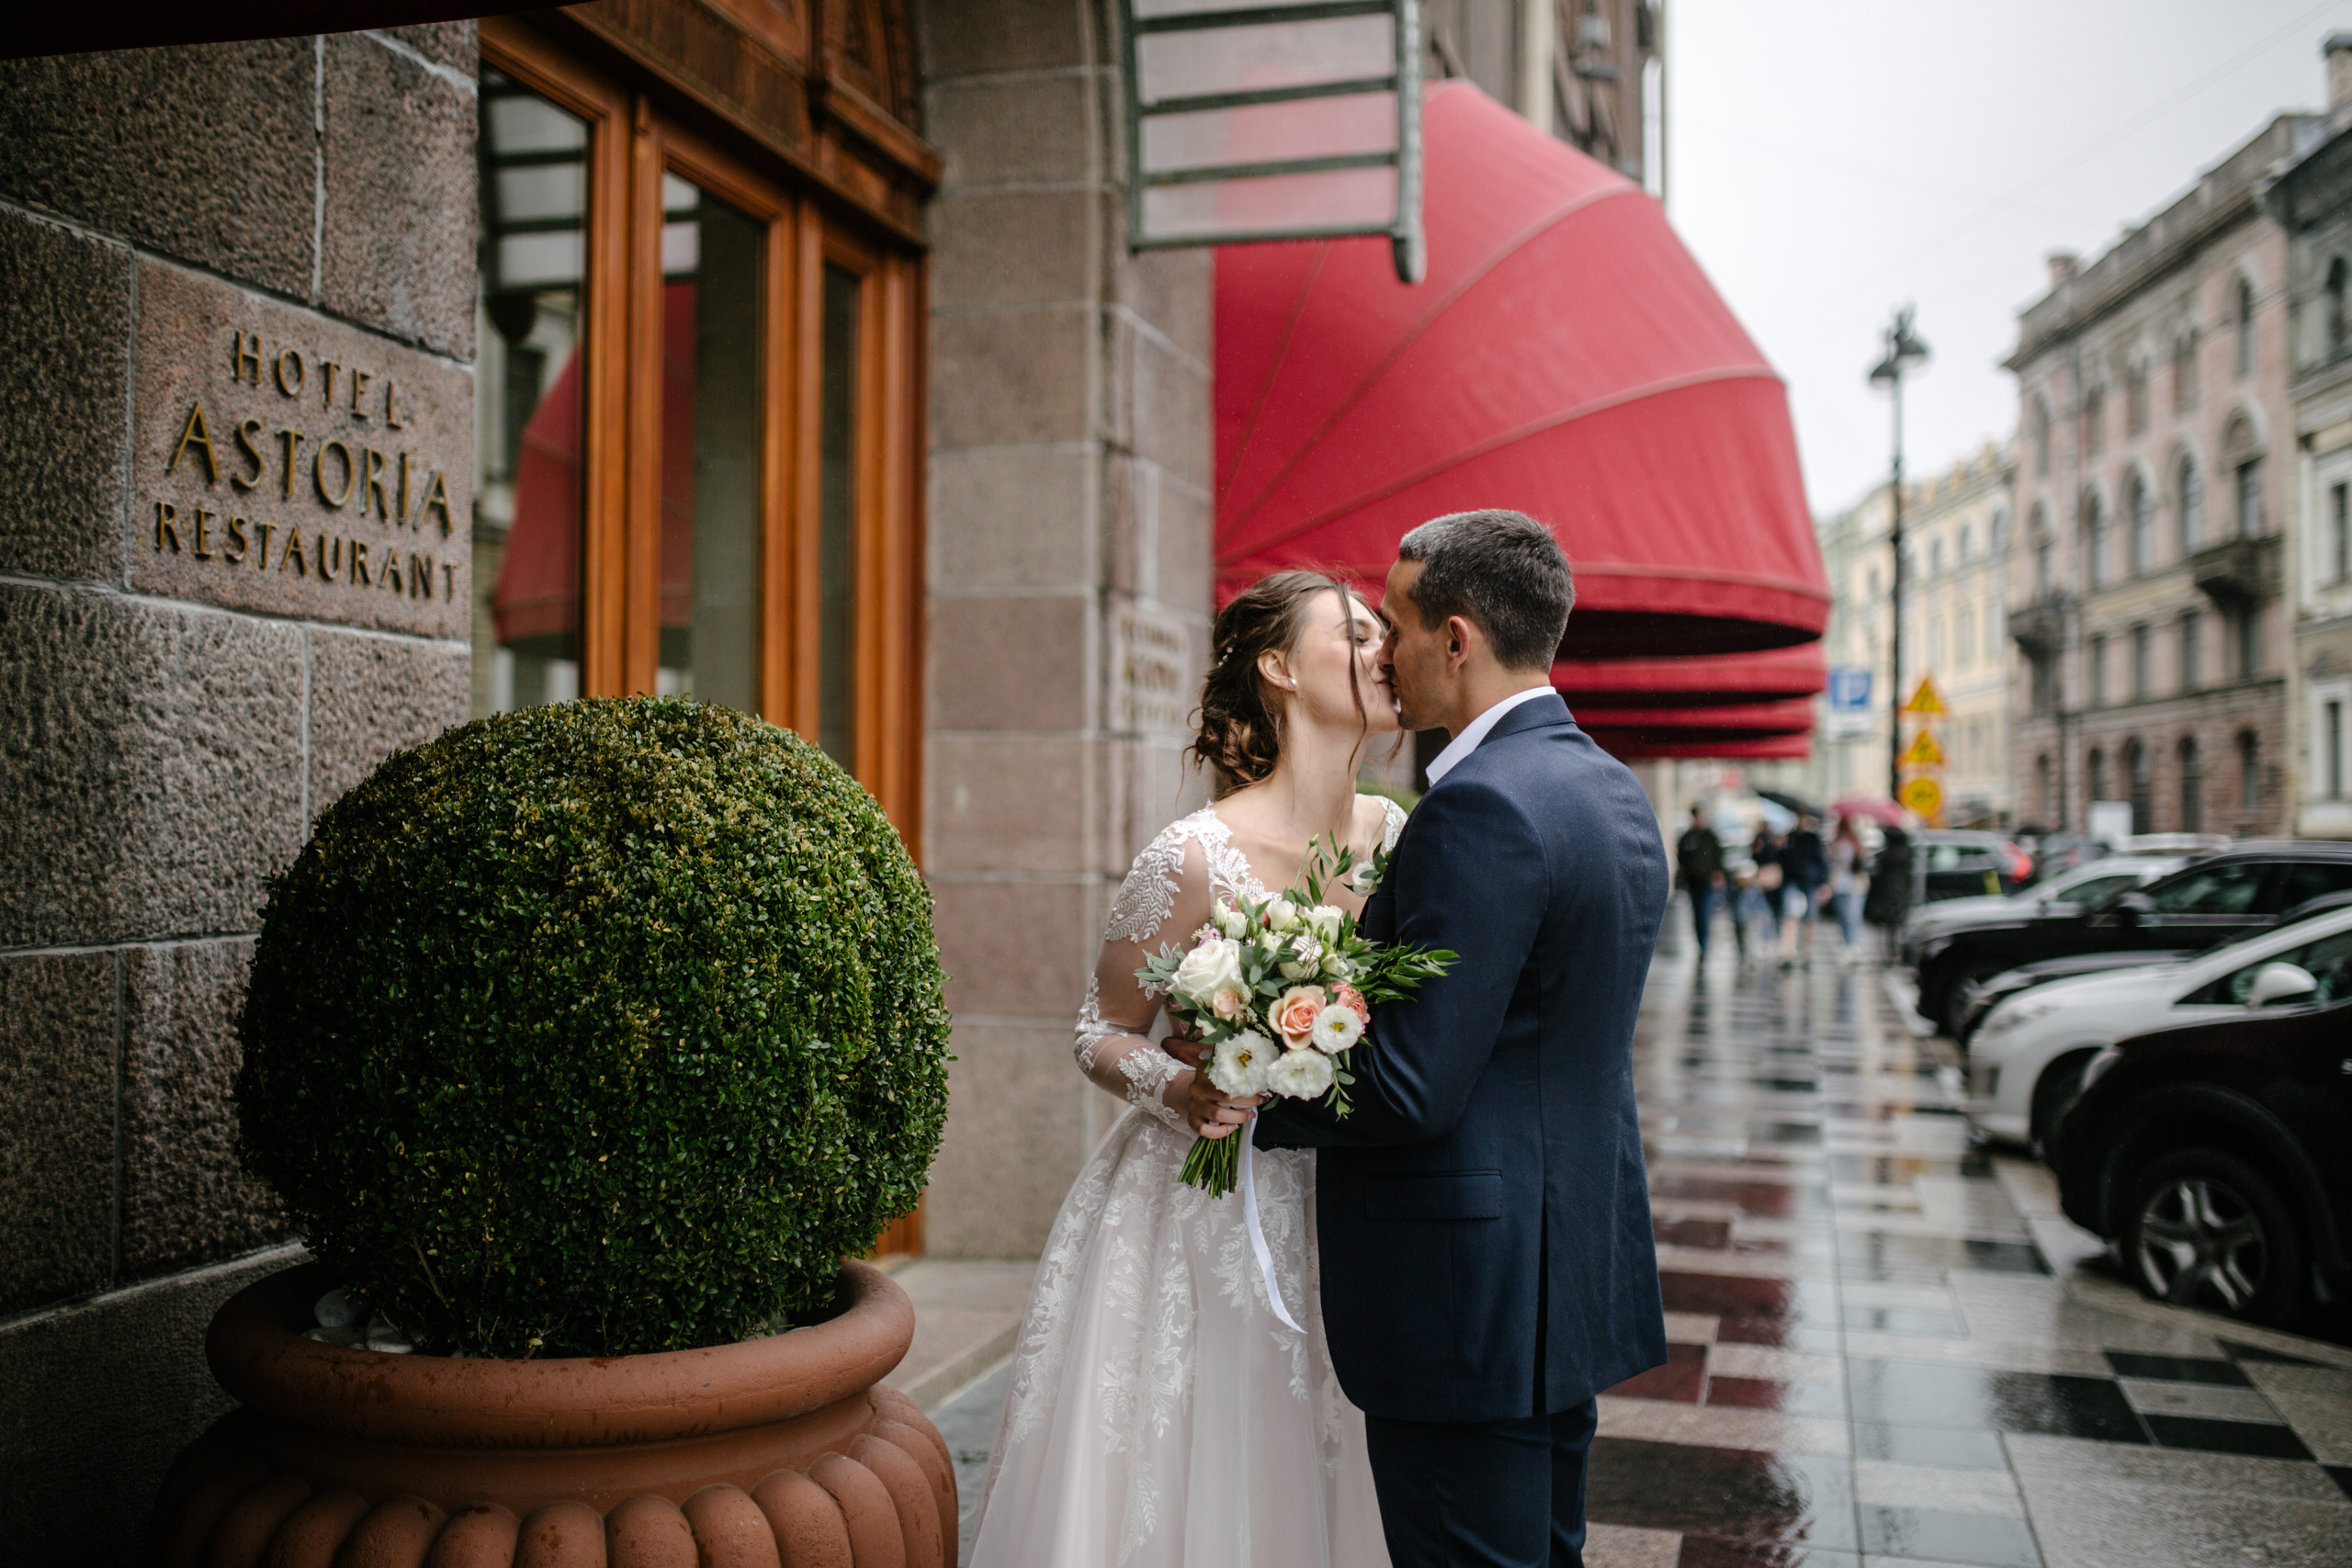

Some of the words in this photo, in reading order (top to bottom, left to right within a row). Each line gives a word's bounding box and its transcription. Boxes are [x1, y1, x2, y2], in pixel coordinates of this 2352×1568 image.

[233, 330, 401, 429] HOTEL
[165, 400, 454, 537] ASTORIA
[155, 501, 458, 604] RESTAURANT
